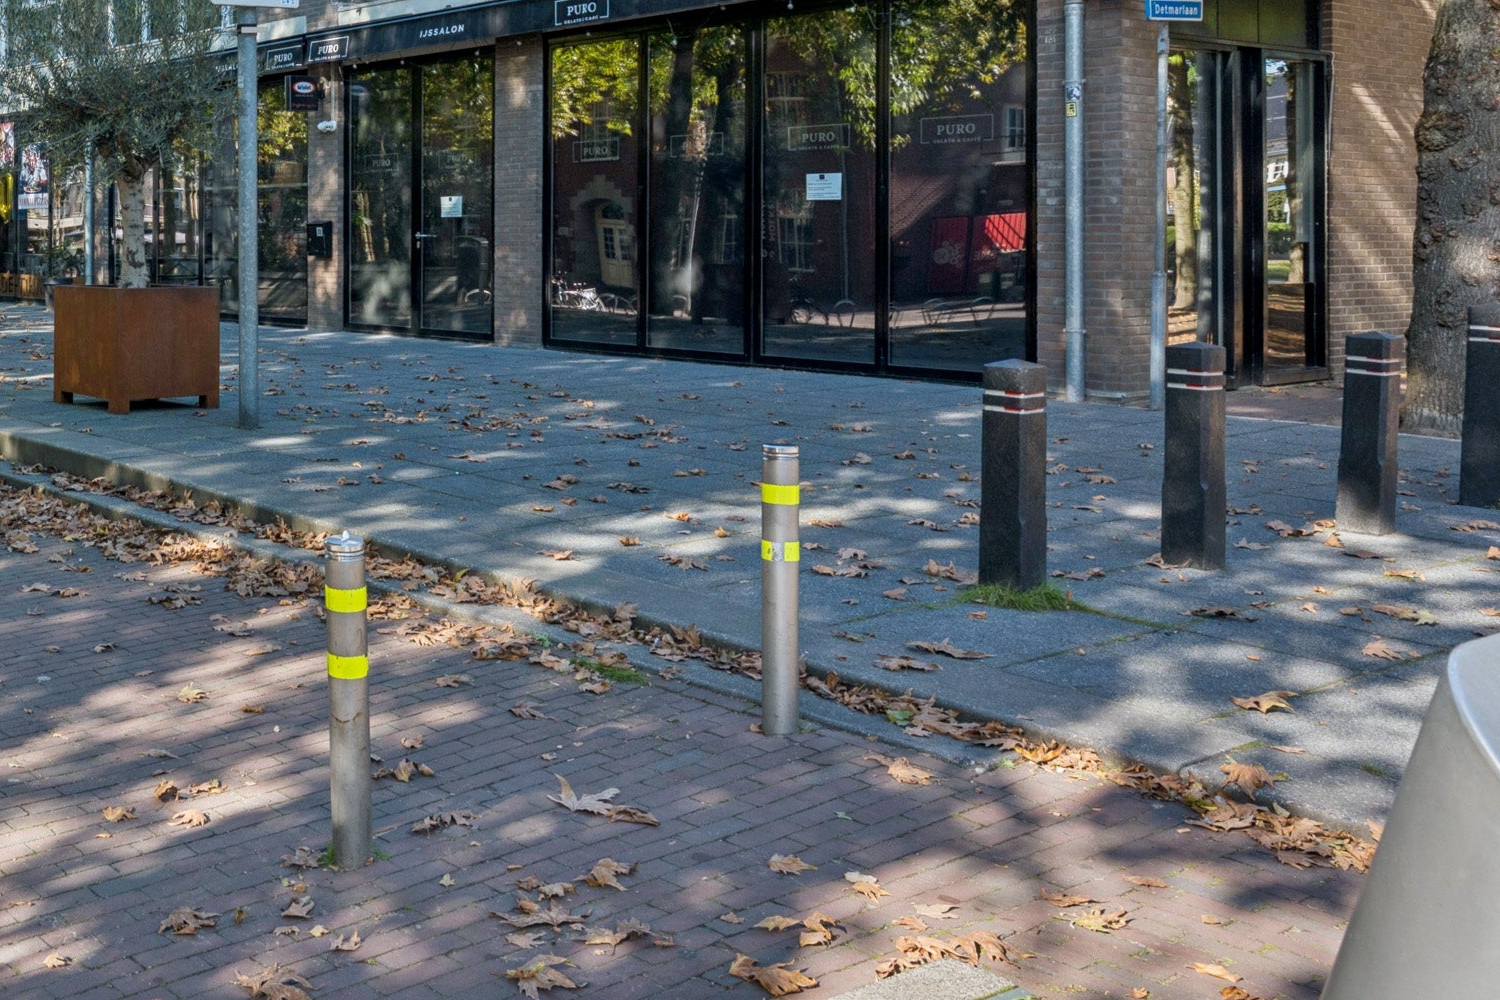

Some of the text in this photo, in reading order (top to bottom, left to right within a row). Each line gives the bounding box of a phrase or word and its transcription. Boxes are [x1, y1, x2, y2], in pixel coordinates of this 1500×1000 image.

[566, 1, 597, 17] PURO
[1154, 2, 1199, 16] Detmarlaan
[419, 23, 465, 38] IJSSALON
[317, 43, 339, 55] PURO
[273, 52, 293, 63] PURO
[936, 122, 976, 136] PURO
[801, 131, 836, 143] PURO
[583, 146, 608, 156] PURO
